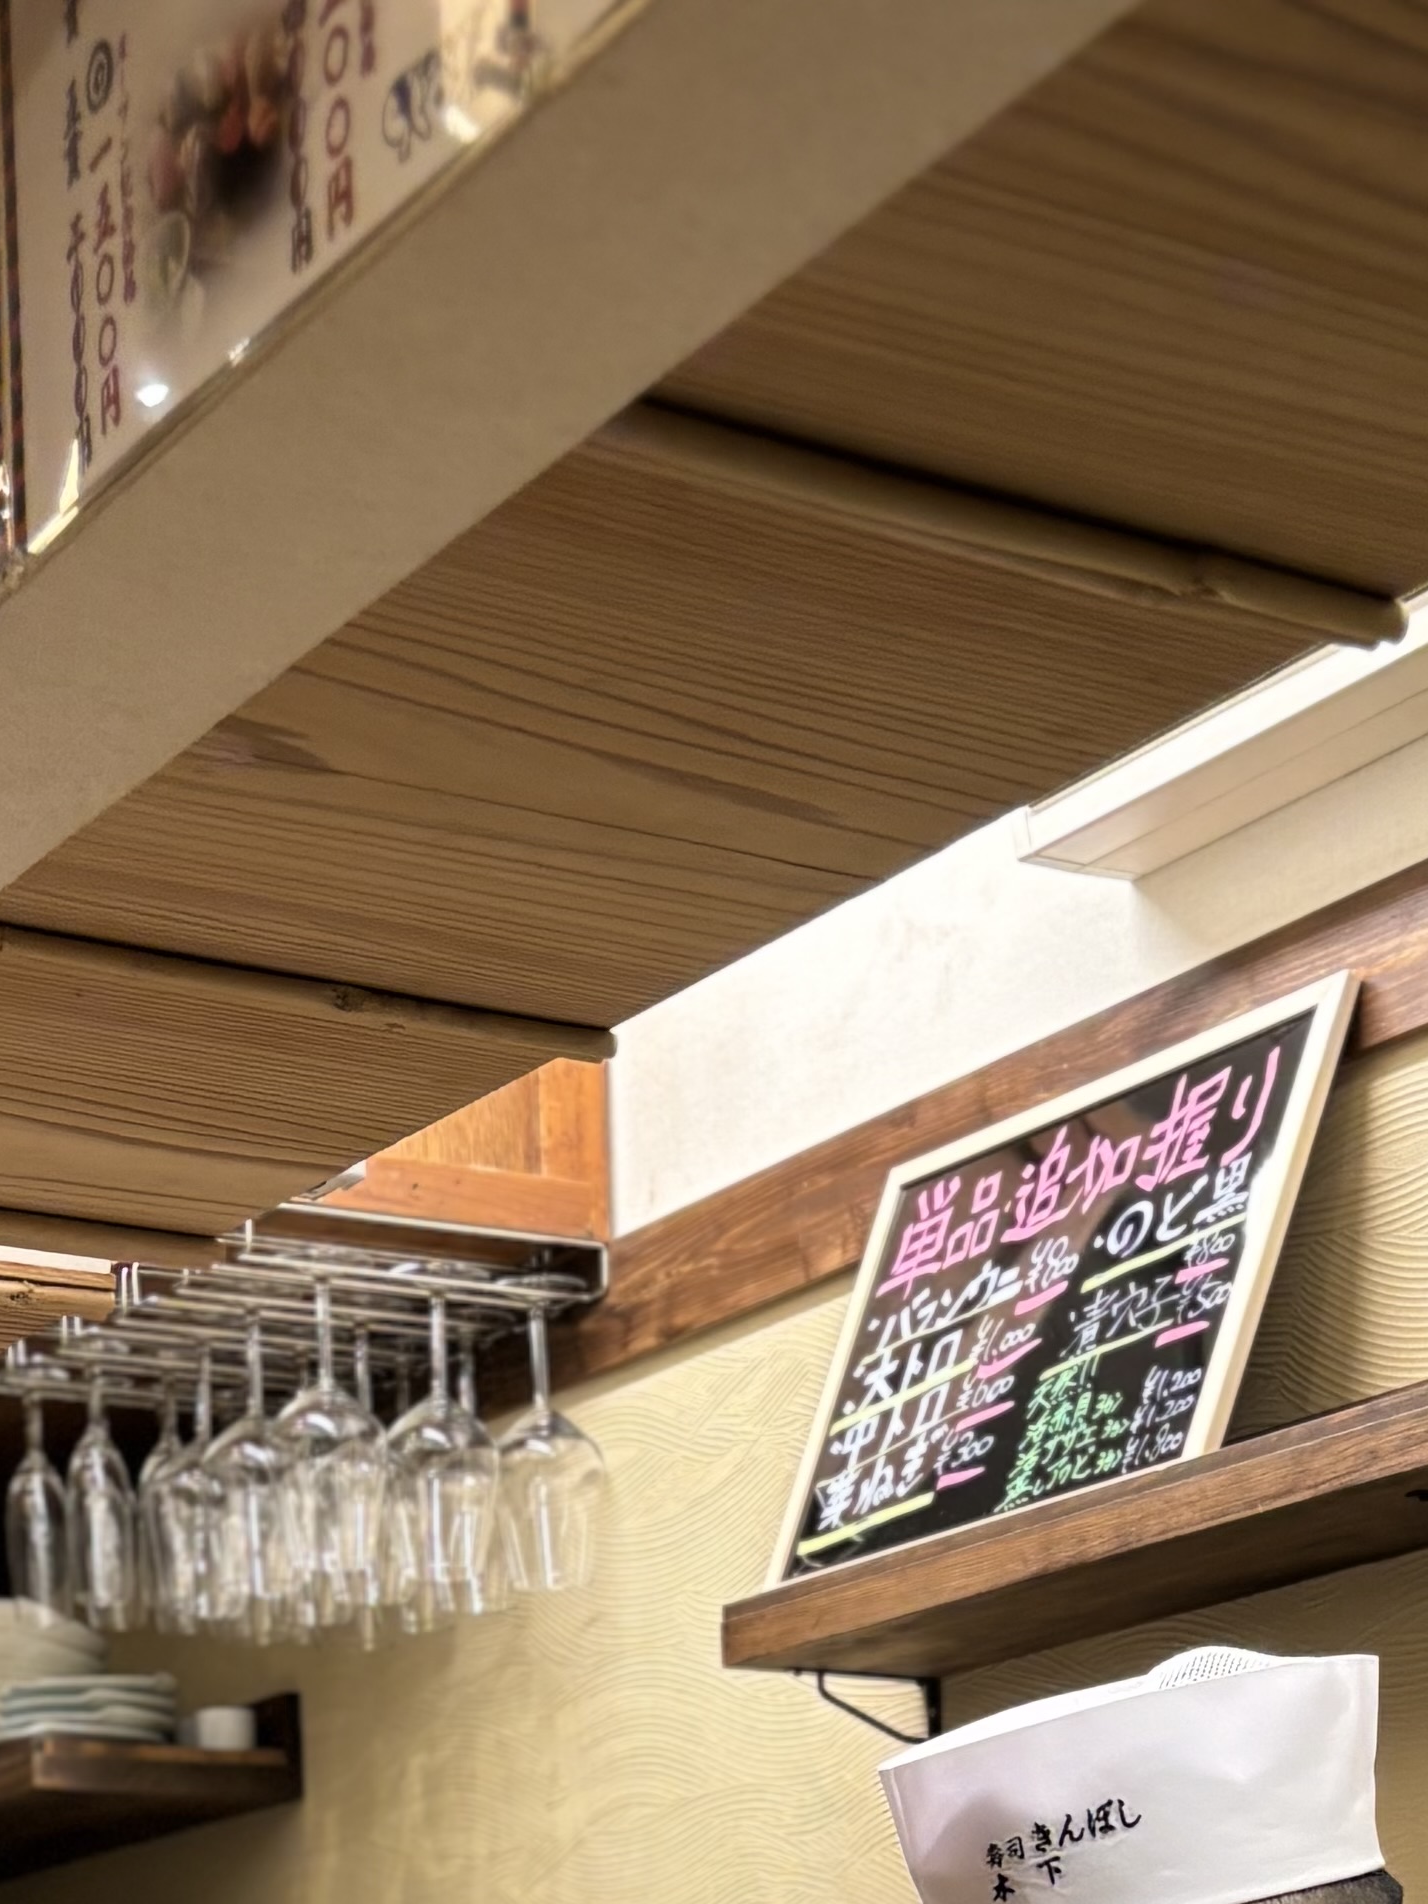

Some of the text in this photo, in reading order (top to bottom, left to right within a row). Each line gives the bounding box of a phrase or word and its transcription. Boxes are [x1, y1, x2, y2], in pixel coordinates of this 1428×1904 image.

[876, 1046, 1280, 1300] 単品追加握り
[1030, 1798, 1142, 1854] きんぼし
